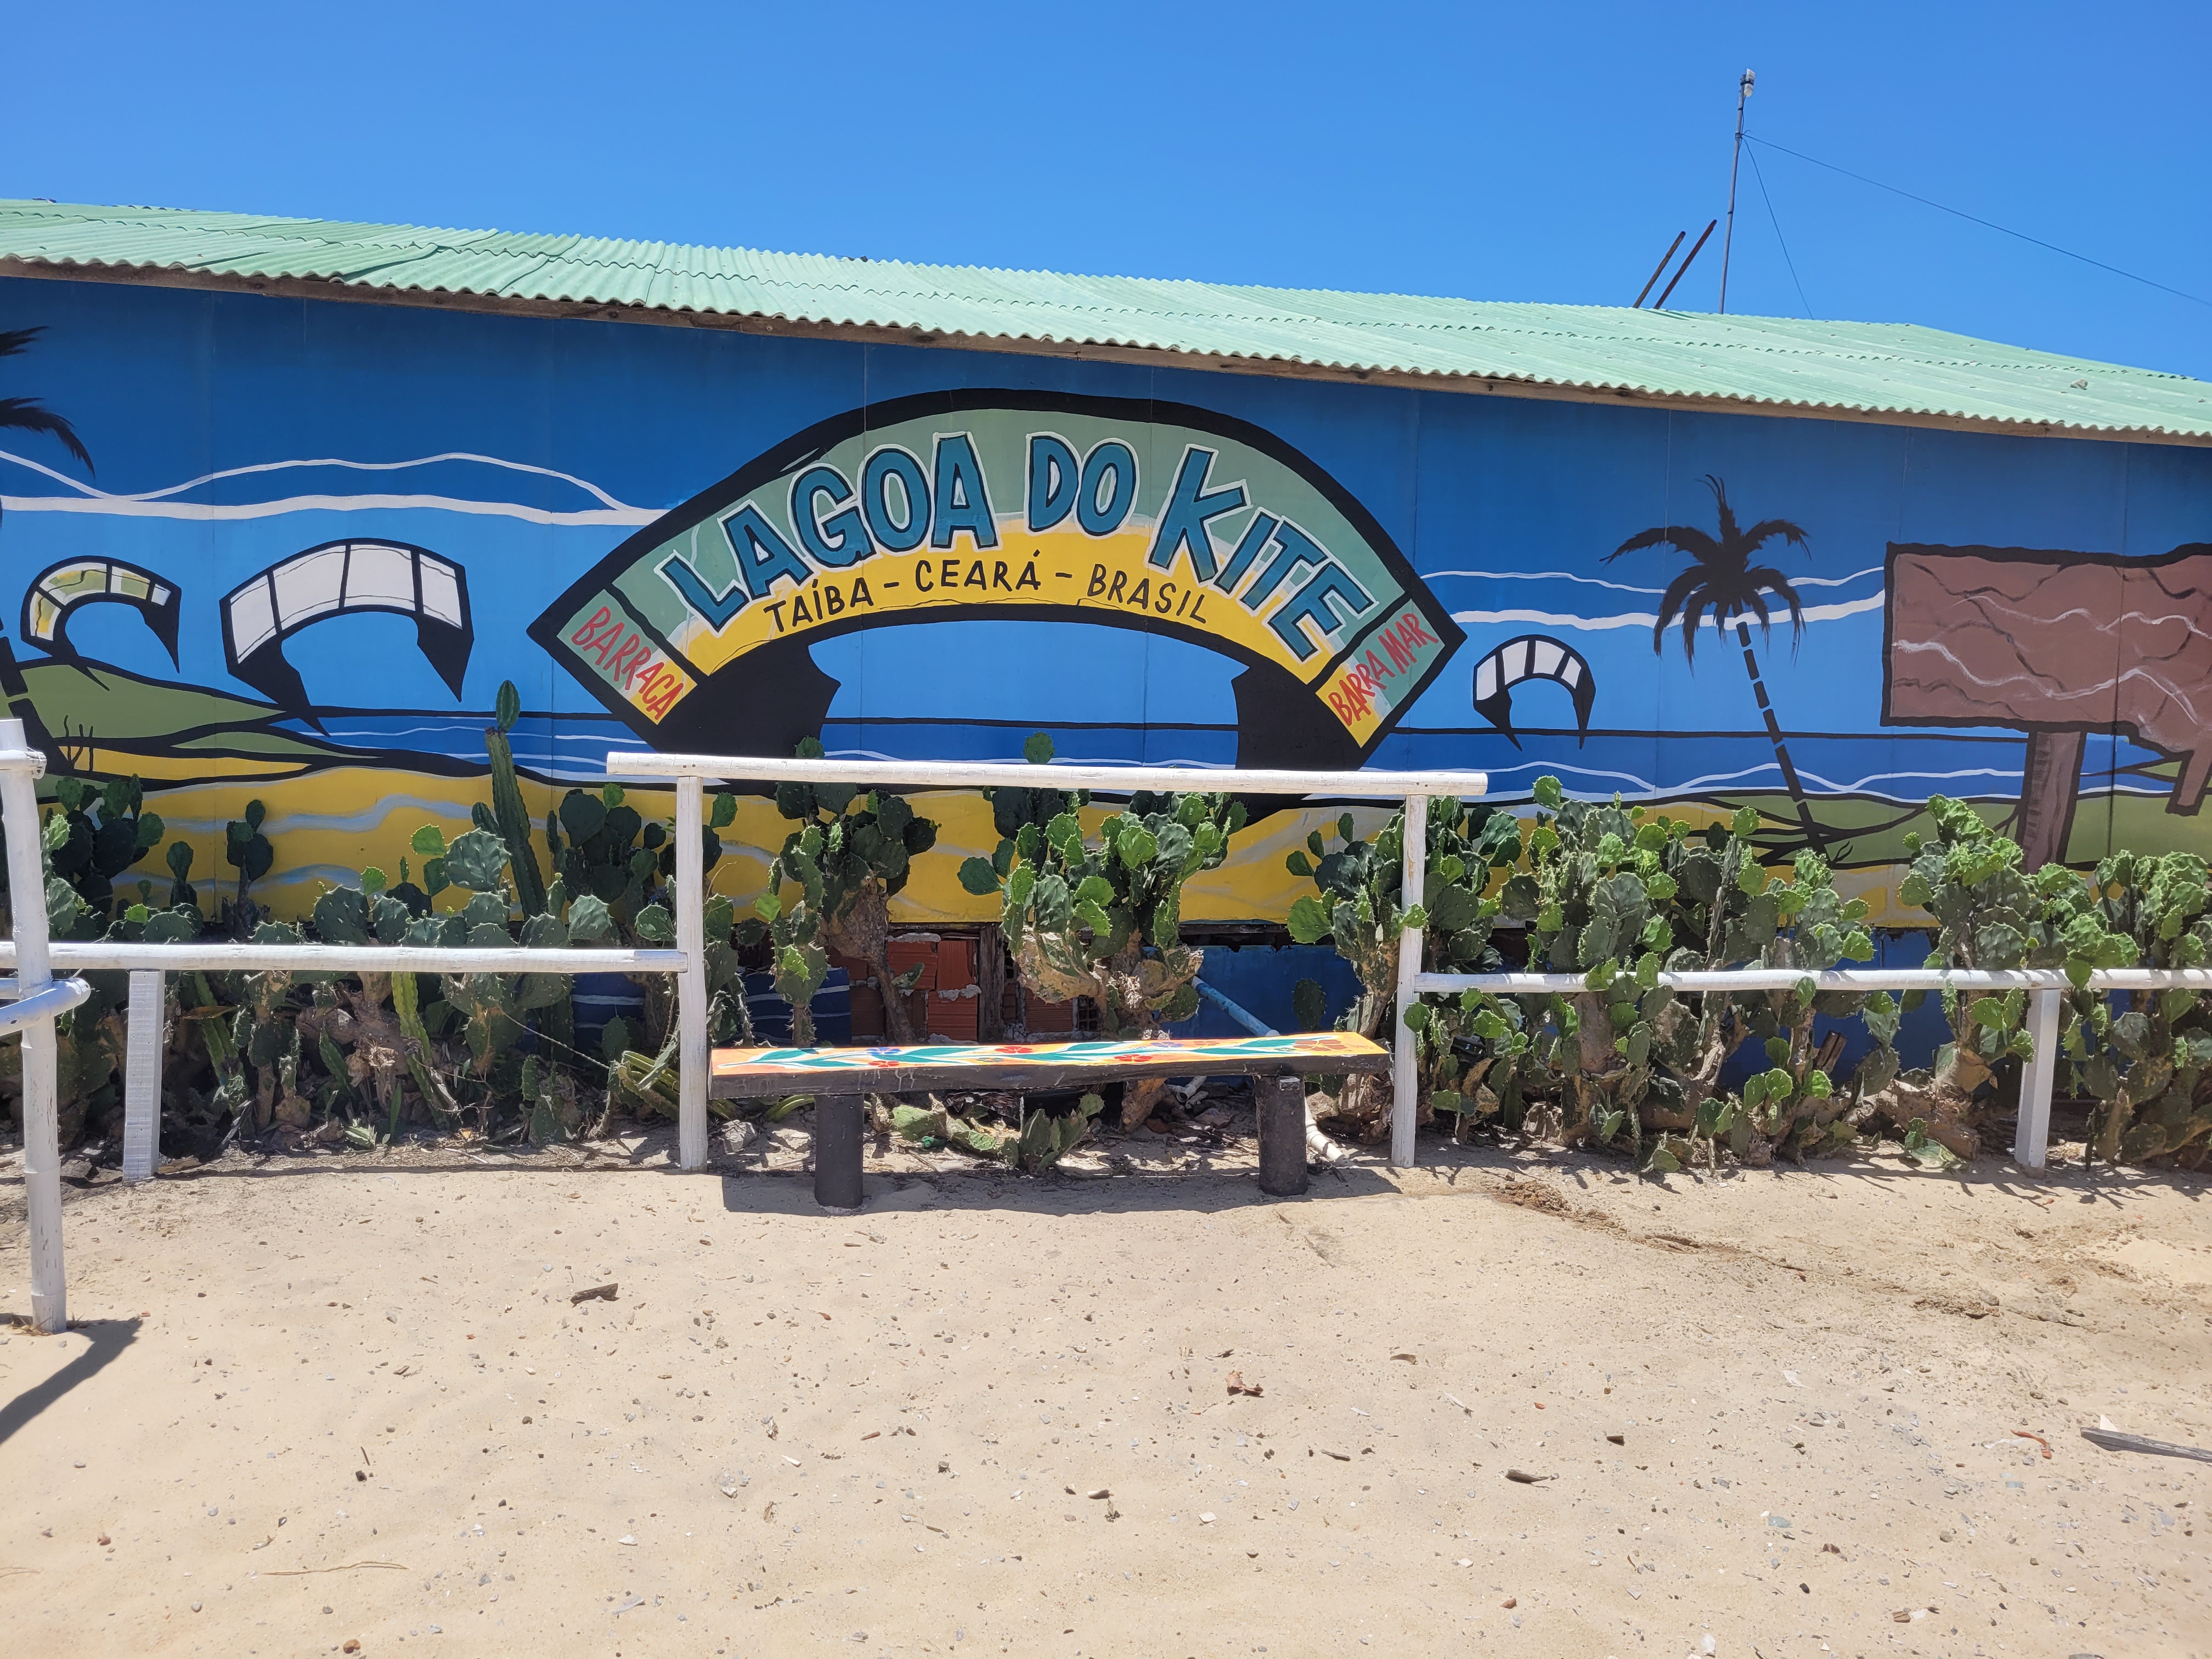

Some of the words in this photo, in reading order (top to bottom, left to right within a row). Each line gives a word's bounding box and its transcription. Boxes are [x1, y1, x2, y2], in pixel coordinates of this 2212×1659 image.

[656, 432, 999, 636] LAGOA
[1026, 432, 1138, 537] DO
[1146, 444, 1378, 663] KITE
[763, 577, 874, 633] TAÍBA
[915, 549, 1041, 592] CEARÁ
[1088, 563, 1206, 624] BRASIL
[571, 606, 684, 721] BARRACA
[1328, 649, 1395, 726] BARRA
[1378, 613, 1438, 675] MAR
